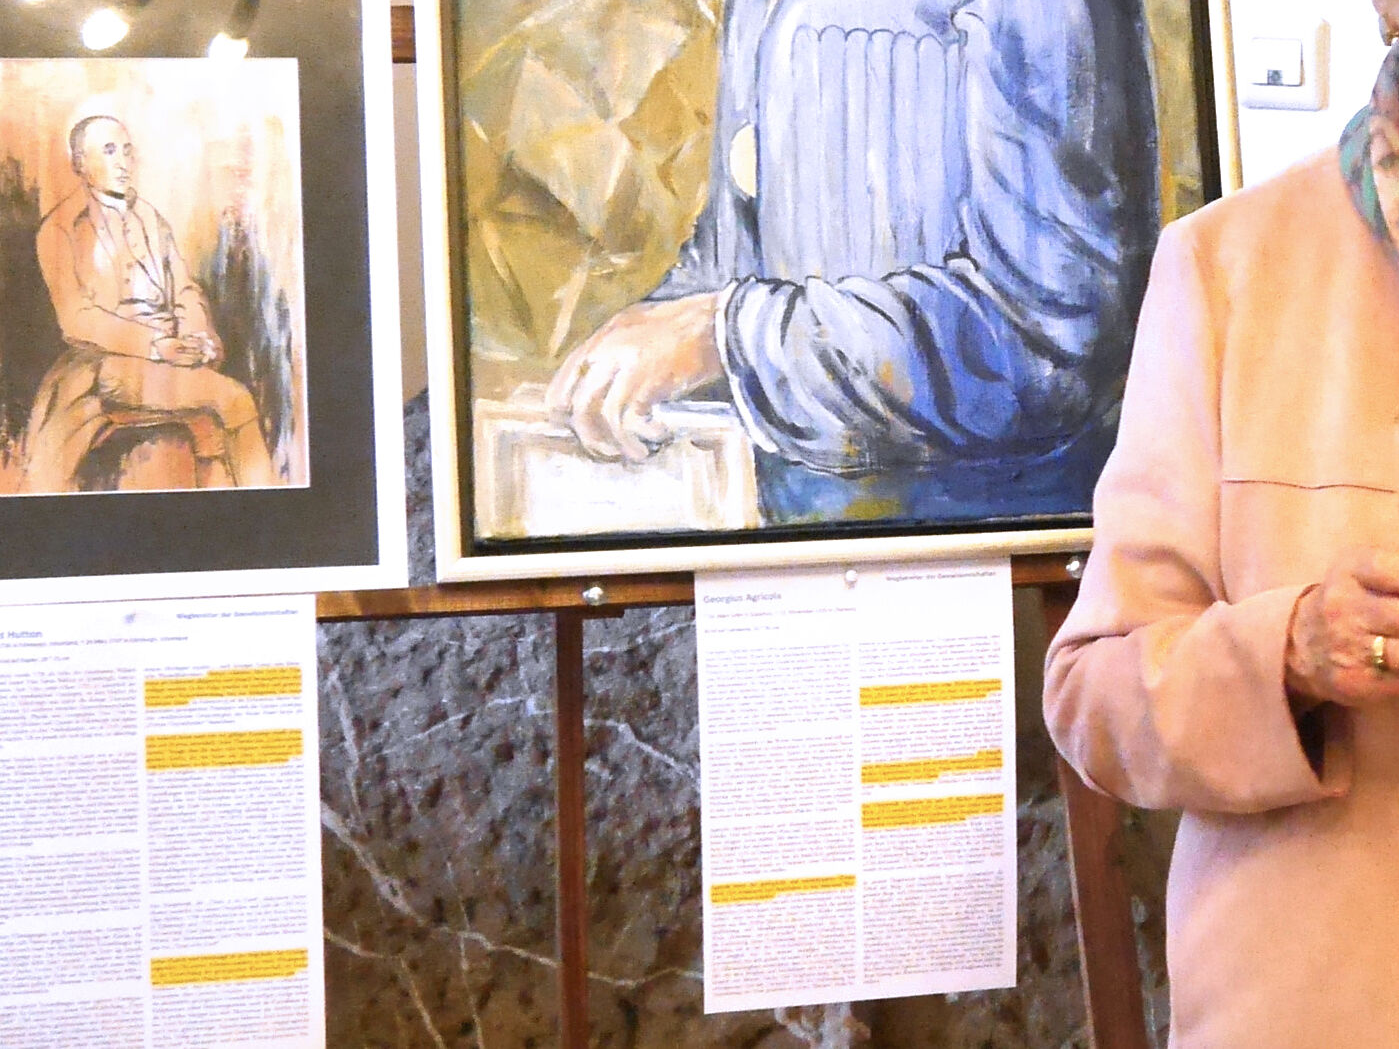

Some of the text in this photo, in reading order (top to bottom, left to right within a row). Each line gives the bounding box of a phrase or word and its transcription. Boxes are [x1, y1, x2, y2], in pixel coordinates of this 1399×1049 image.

[703, 592, 782, 604] Georgius Agricola
[7, 630, 43, 638] Hutton
